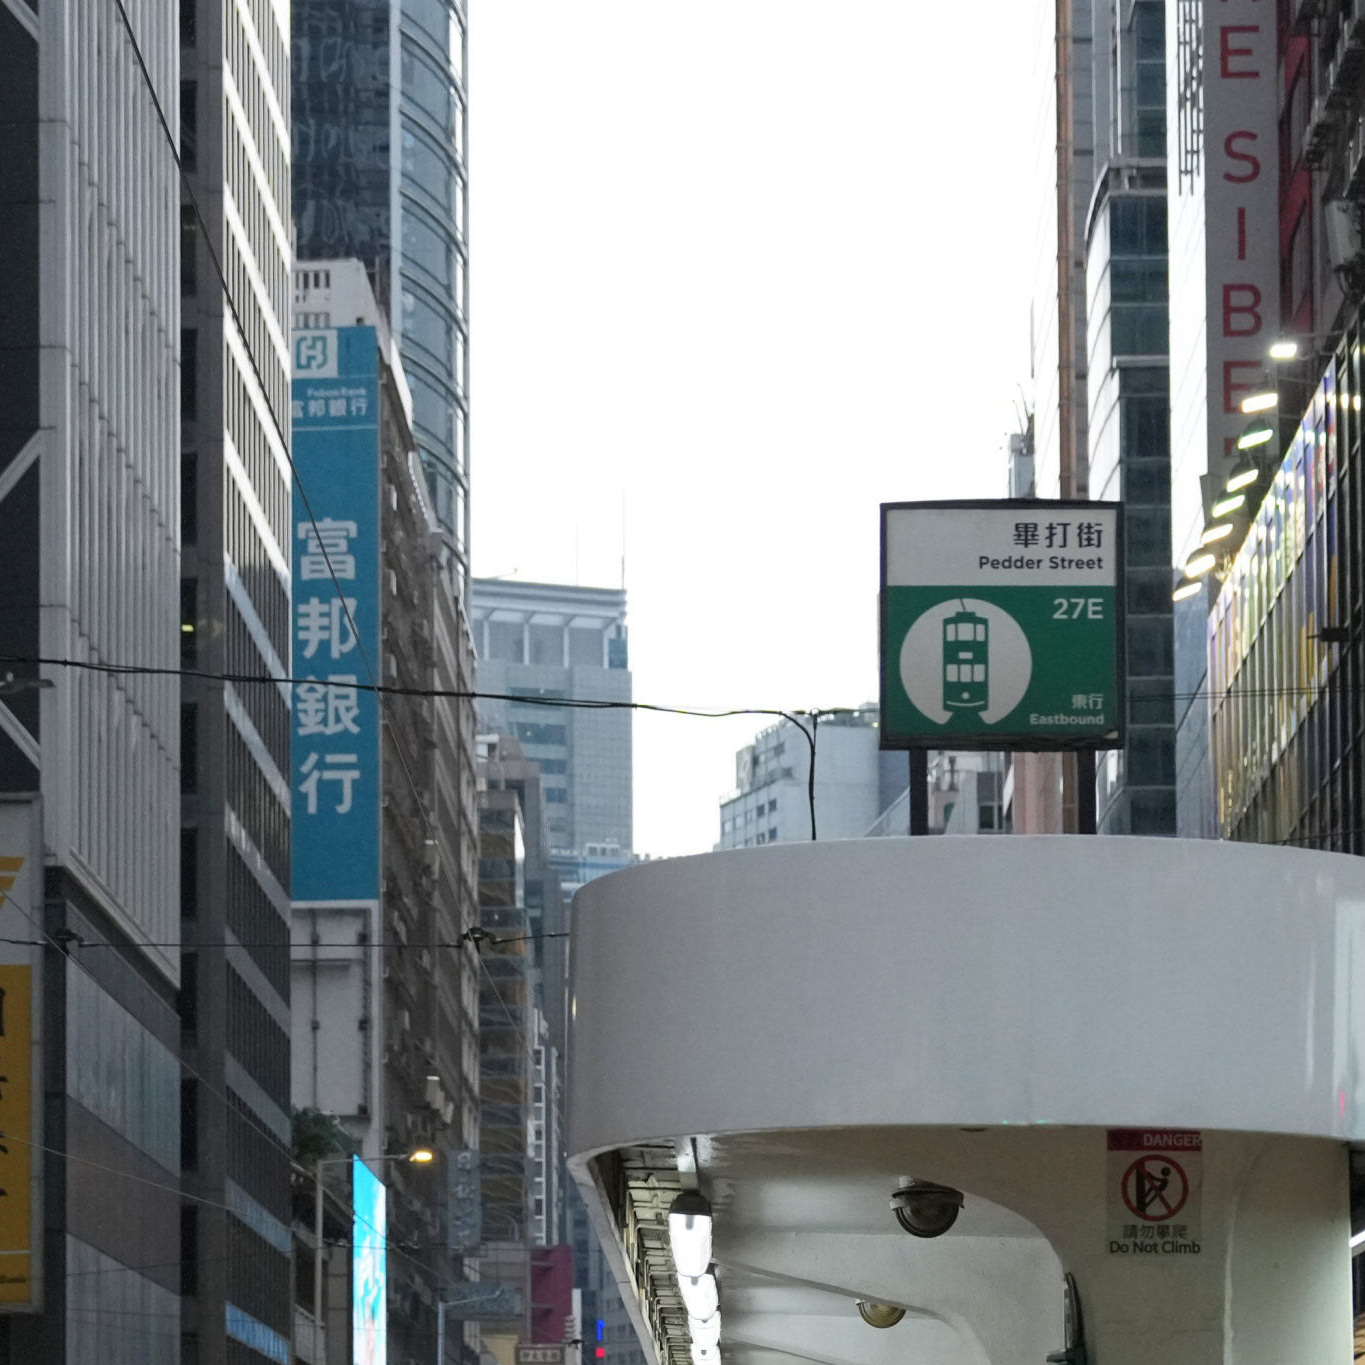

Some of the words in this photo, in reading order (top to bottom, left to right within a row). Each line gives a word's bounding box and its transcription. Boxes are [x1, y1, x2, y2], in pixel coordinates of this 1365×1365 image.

[1013, 522, 1103, 549] 畢打街
[979, 556, 1043, 570] Pedder
[1049, 556, 1104, 570] Street
[1052, 597, 1104, 620] 27E
[297, 518, 361, 815] 富邦銀行
[1071, 693, 1103, 710] 東行
[1029, 713, 1105, 726] Eastbound
[1143, 1133, 1202, 1147] DANGER
[1110, 1240, 1129, 1254] Do
[1133, 1240, 1158, 1254] Not
[1161, 1240, 1200, 1254] Climb
